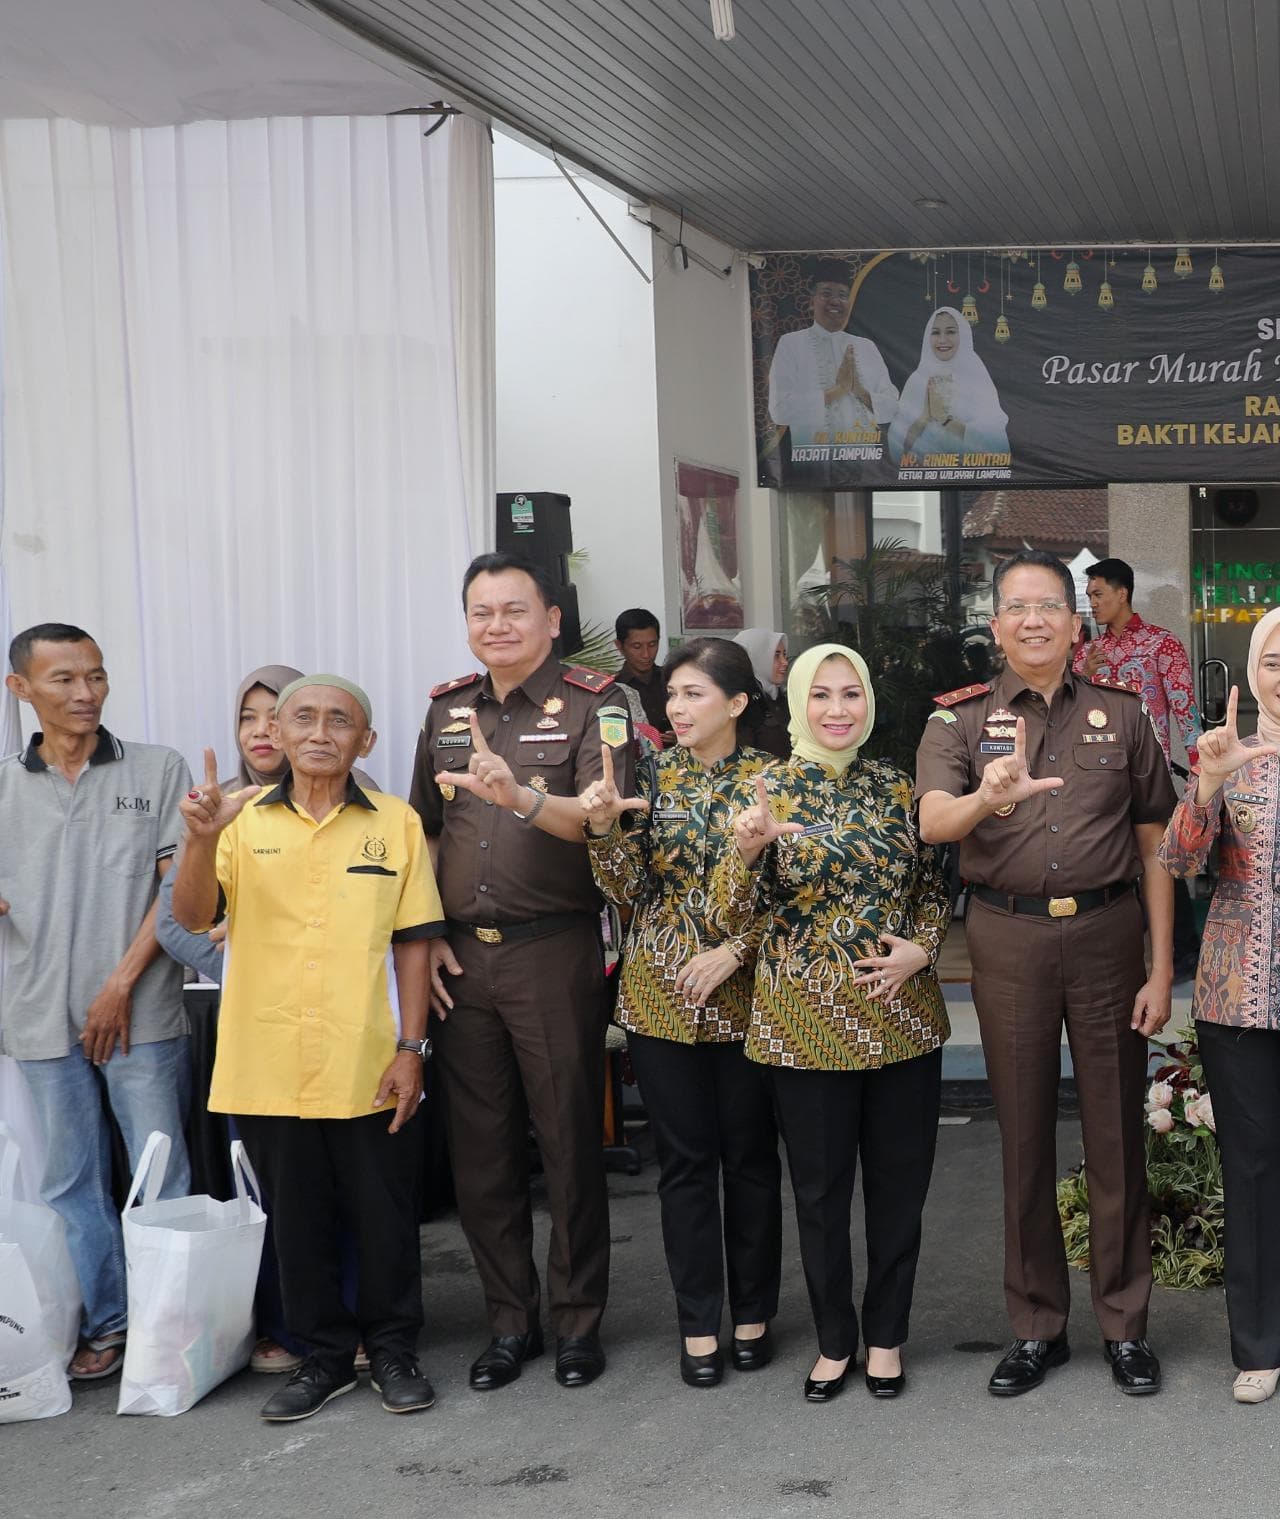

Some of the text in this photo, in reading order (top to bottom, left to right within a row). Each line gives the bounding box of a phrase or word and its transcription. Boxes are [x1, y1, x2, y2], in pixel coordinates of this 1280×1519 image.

[1041, 355, 1140, 385] Pasar
[1147, 348, 1263, 384] Murah
[834, 431, 882, 444] KUNTADI
[1117, 423, 1197, 445] BAKTI
[791, 446, 884, 462] KAJATI LAMPUNG
[922, 453, 960, 467] RINNIE
[961, 452, 1012, 467] KUNTADI
[898, 470, 923, 480] KETUA
[939, 470, 975, 480] WILAYAH
[975, 469, 1012, 480] LAMPUNG
[1233, 792, 1266, 803] JIHAN
